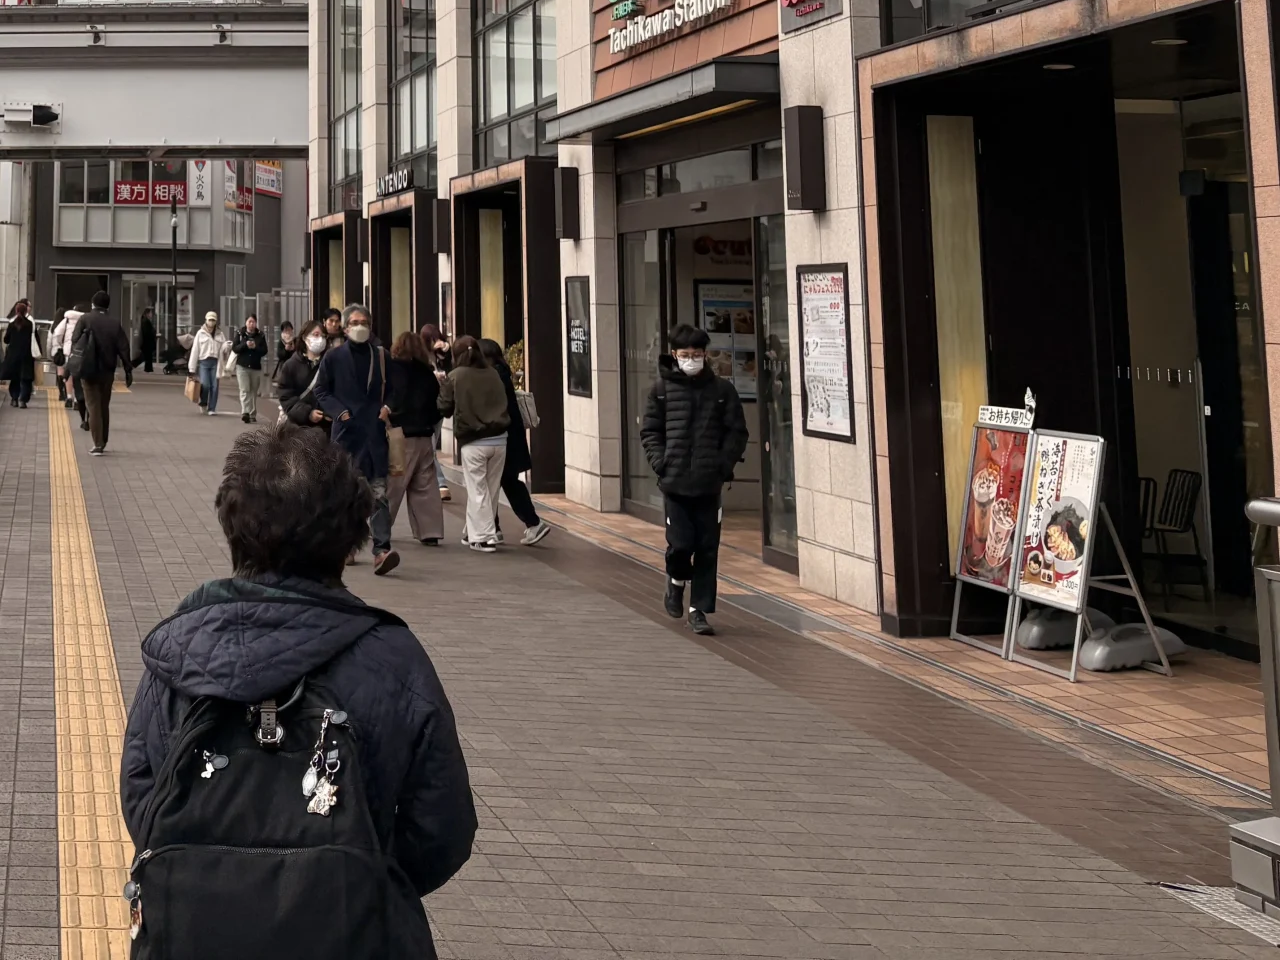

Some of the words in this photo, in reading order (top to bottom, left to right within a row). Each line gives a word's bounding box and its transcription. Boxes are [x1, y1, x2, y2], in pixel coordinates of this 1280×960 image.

[608, 9, 675, 55] Tachikawa
[116, 184, 146, 201] 漢方
[154, 184, 184, 201] 相談
[195, 174, 205, 201] 火の鳥
